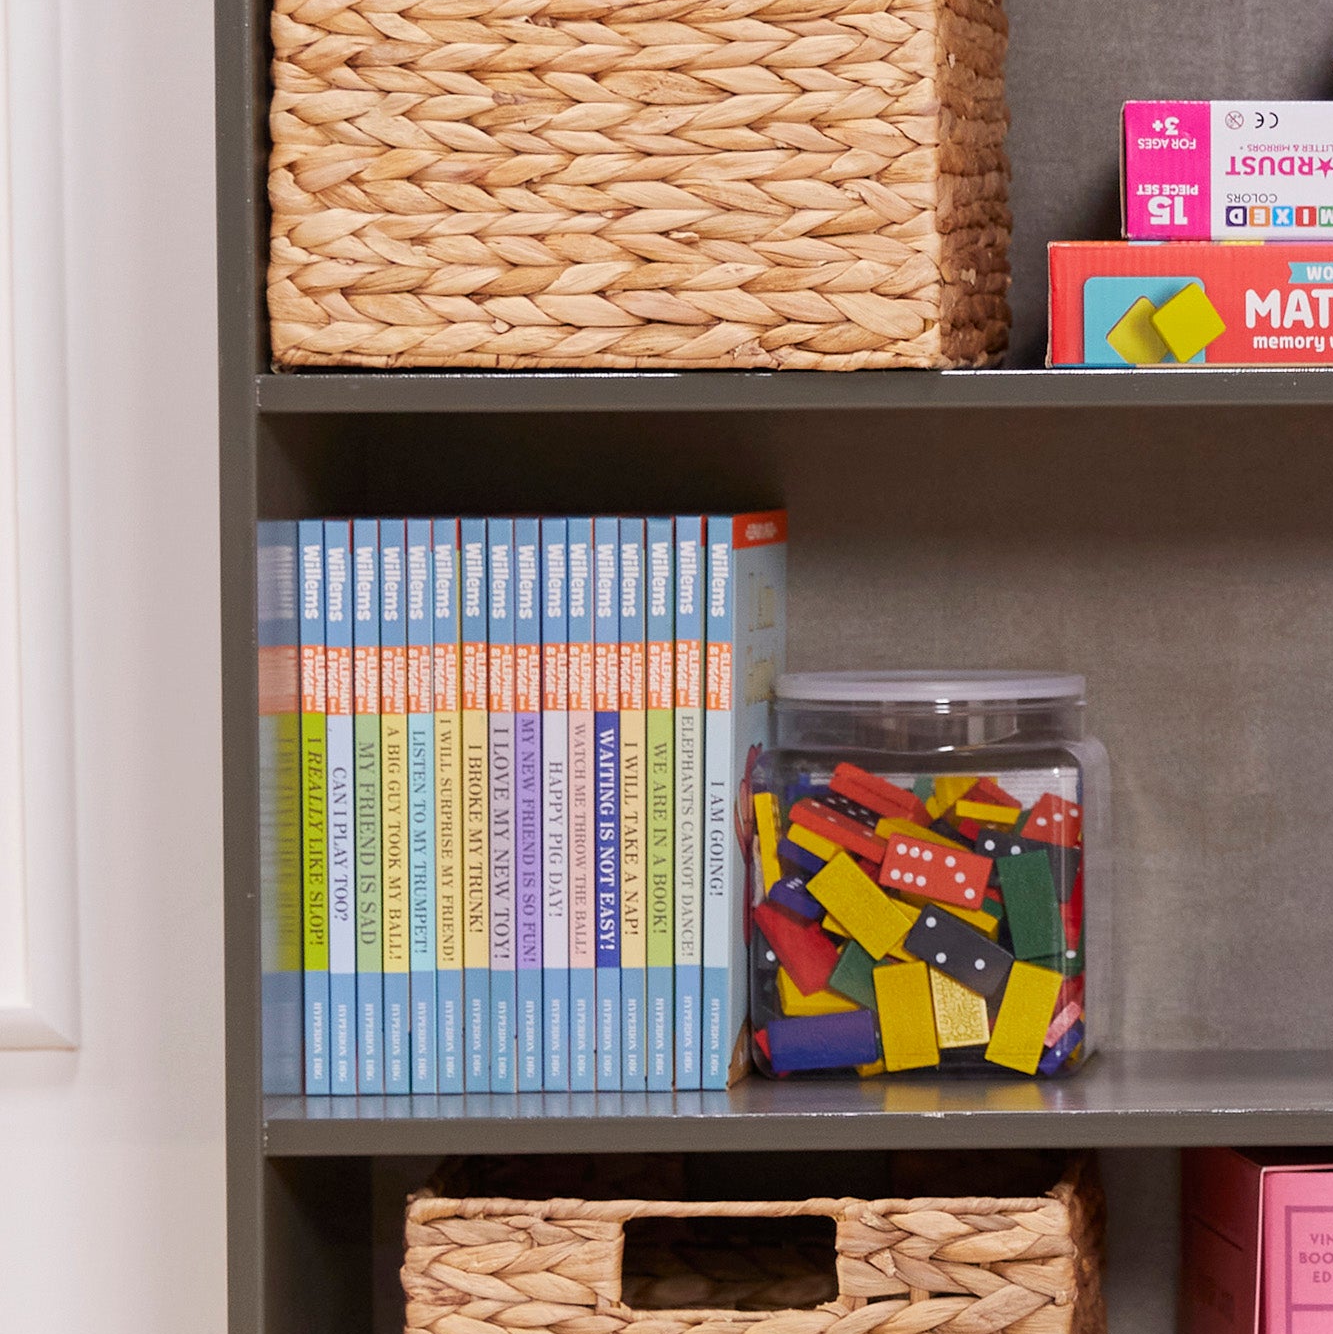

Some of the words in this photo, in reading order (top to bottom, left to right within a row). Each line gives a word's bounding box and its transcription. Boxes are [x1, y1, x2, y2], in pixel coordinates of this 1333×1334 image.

[1138, 138, 1171, 149] AGES
[1152, 116, 1179, 135] 3+
[1172, 138, 1196, 149] FOR
[1247, 144, 1290, 152] MIRRORS
[1292, 144, 1299, 152] &
[1136, 184, 1159, 195] SET
[1148, 195, 1188, 225] 15
[1161, 184, 1198, 195] PIECE
[1226, 193, 1278, 203] COLORS
[1253, 333, 1325, 352] memory
[387, 726, 400, 737] A
[439, 730, 452, 773] WILL
[358, 742, 375, 774] MY
[387, 744, 401, 774] BIG
[412, 731, 426, 794] LISTEN
[493, 742, 510, 801] LOVE
[599, 728, 615, 817] WAITING
[652, 742, 668, 774] WE
[681, 715, 694, 816] ELEPHANTS
[307, 751, 323, 833] REALLY
[332, 766, 347, 805] CAN
[387, 779, 401, 815] GUY
[468, 757, 483, 823] BROKE
[548, 761, 563, 825] HAPPY
[624, 755, 639, 805] WILL
[652, 780, 668, 821] ARE
[358, 783, 376, 866] FRIEND
[413, 799, 427, 824] TO
[440, 777, 453, 859] SURPRISE
[493, 808, 510, 841] MY
[710, 794, 725, 822] AM
[333, 823, 348, 866] PLAY
[387, 821, 402, 869] TOOK
[413, 829, 427, 855] MY
[468, 829, 483, 856] MY
[548, 833, 563, 865] PIG
[599, 822, 614, 842] IS
[624, 811, 639, 865] TAKE
[653, 828, 668, 847] IN
[308, 837, 324, 885] LIKE
[493, 849, 510, 901] NEW
[599, 847, 615, 887] NOT
[652, 854, 667, 866] A
[681, 820, 694, 889] CANNOT
[709, 829, 724, 896] GOING!
[359, 874, 377, 894] IS
[388, 876, 402, 899] MY
[441, 865, 454, 888] MY
[468, 861, 484, 933] TRUNK!
[548, 872, 563, 917] DAY!
[624, 871, 638, 883] A
[309, 890, 325, 946] SLOP!
[333, 874, 348, 922] TOO?
[413, 860, 428, 954] TRUMPET!
[624, 890, 639, 935] NAP!
[652, 873, 668, 934] BOOK!
[360, 901, 377, 945] SAD
[388, 908, 402, 960] BALL!
[441, 895, 455, 962] FRIEND!
[493, 907, 510, 959] TOY!
[599, 892, 616, 950] EASY!
[681, 894, 694, 957] DANCE!
